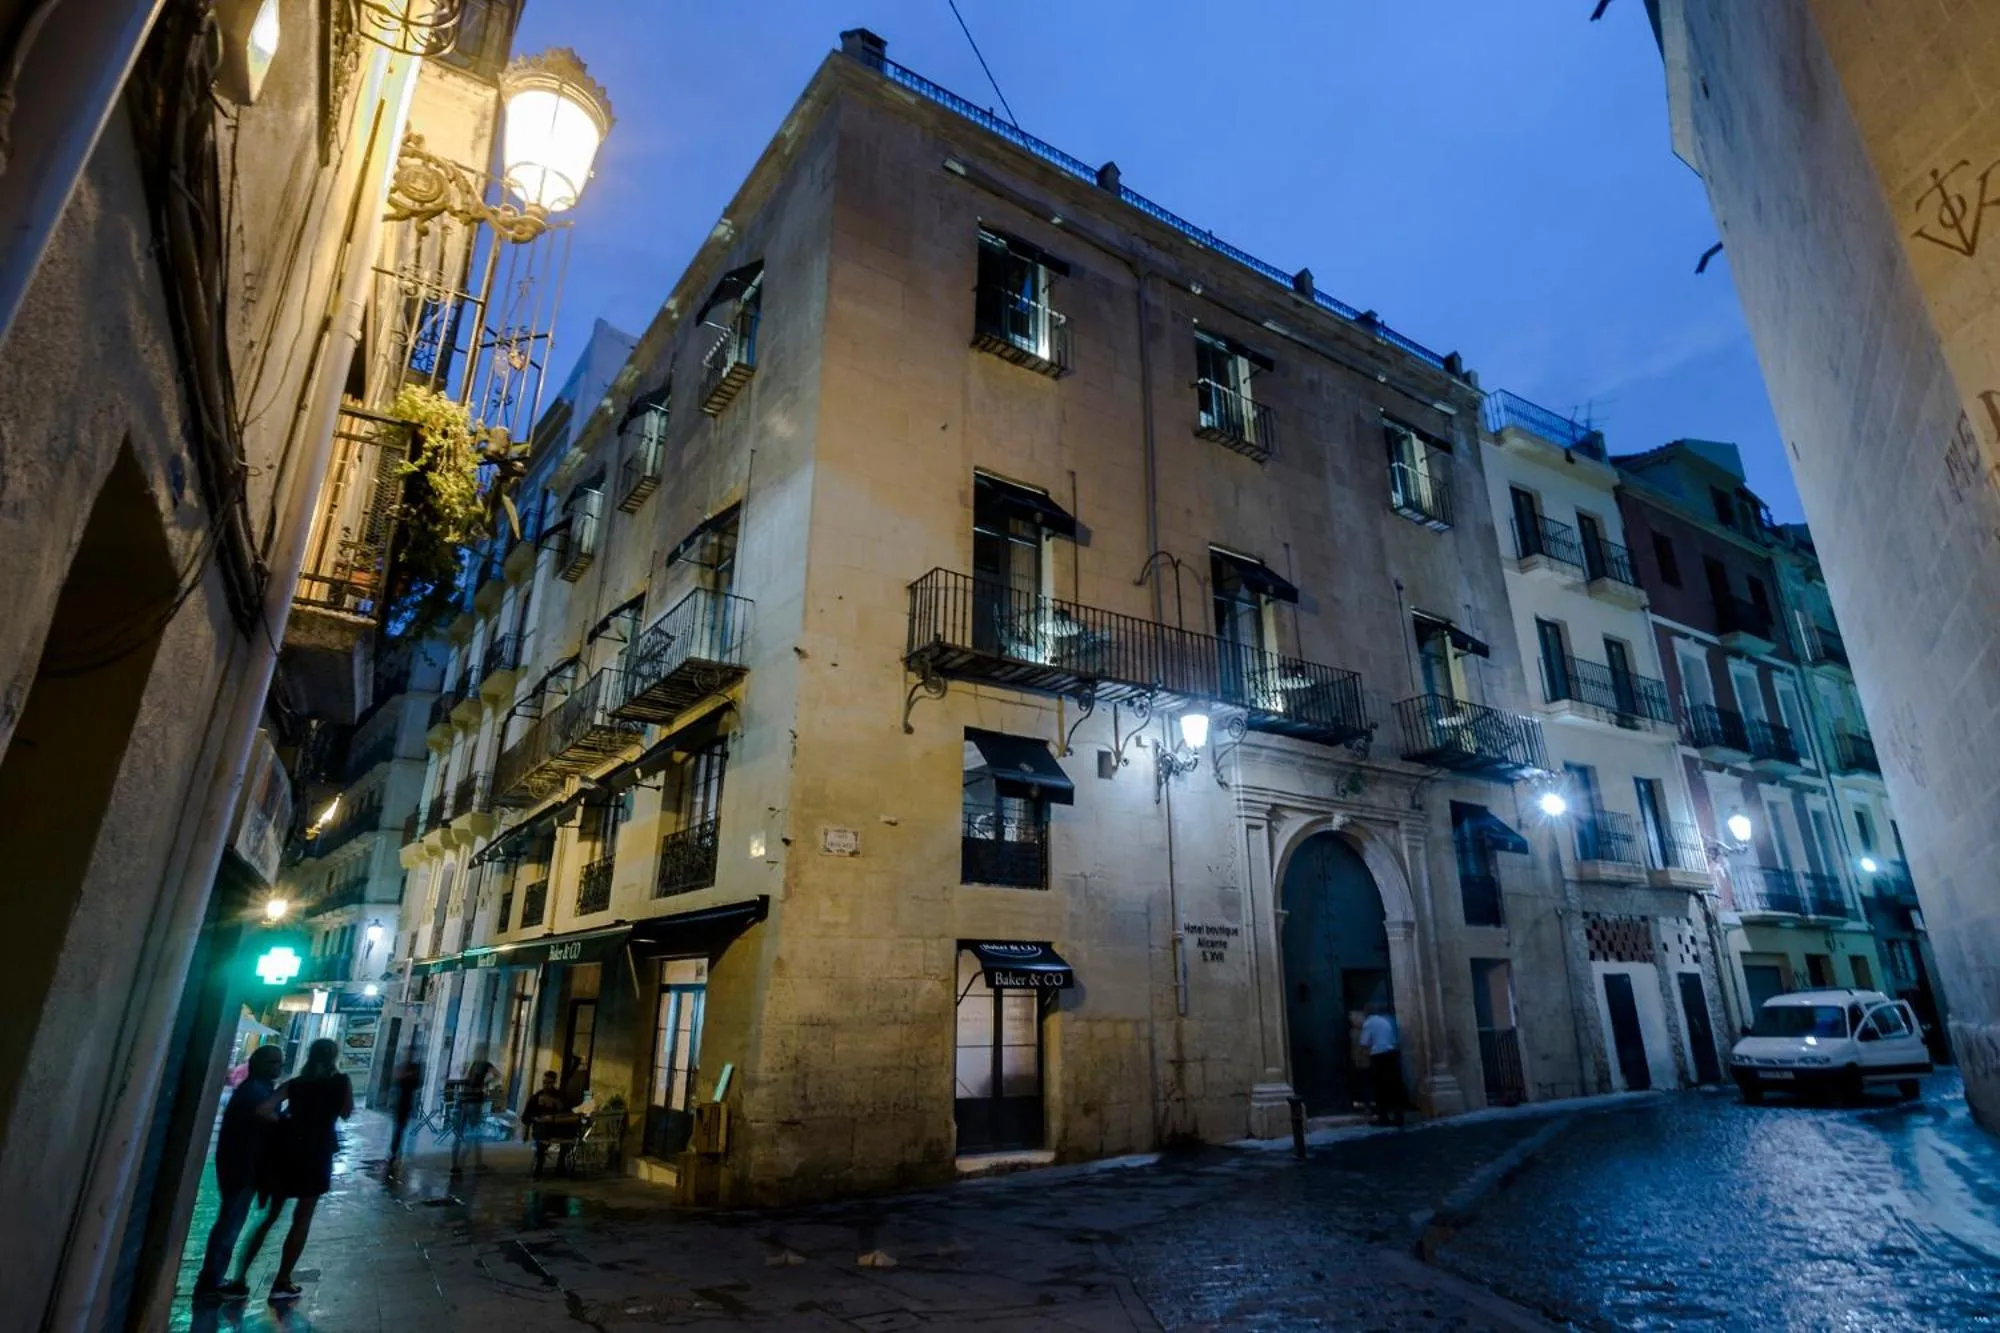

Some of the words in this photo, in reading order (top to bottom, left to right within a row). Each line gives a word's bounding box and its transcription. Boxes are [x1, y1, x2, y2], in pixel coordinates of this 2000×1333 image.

[1183, 921, 1205, 934] Hotel
[1205, 923, 1238, 938] boutique
[1196, 937, 1227, 949] Alicante
[995, 971, 1025, 986] Baker
[1028, 972, 1041, 987] &
[1043, 973, 1064, 987] CO
